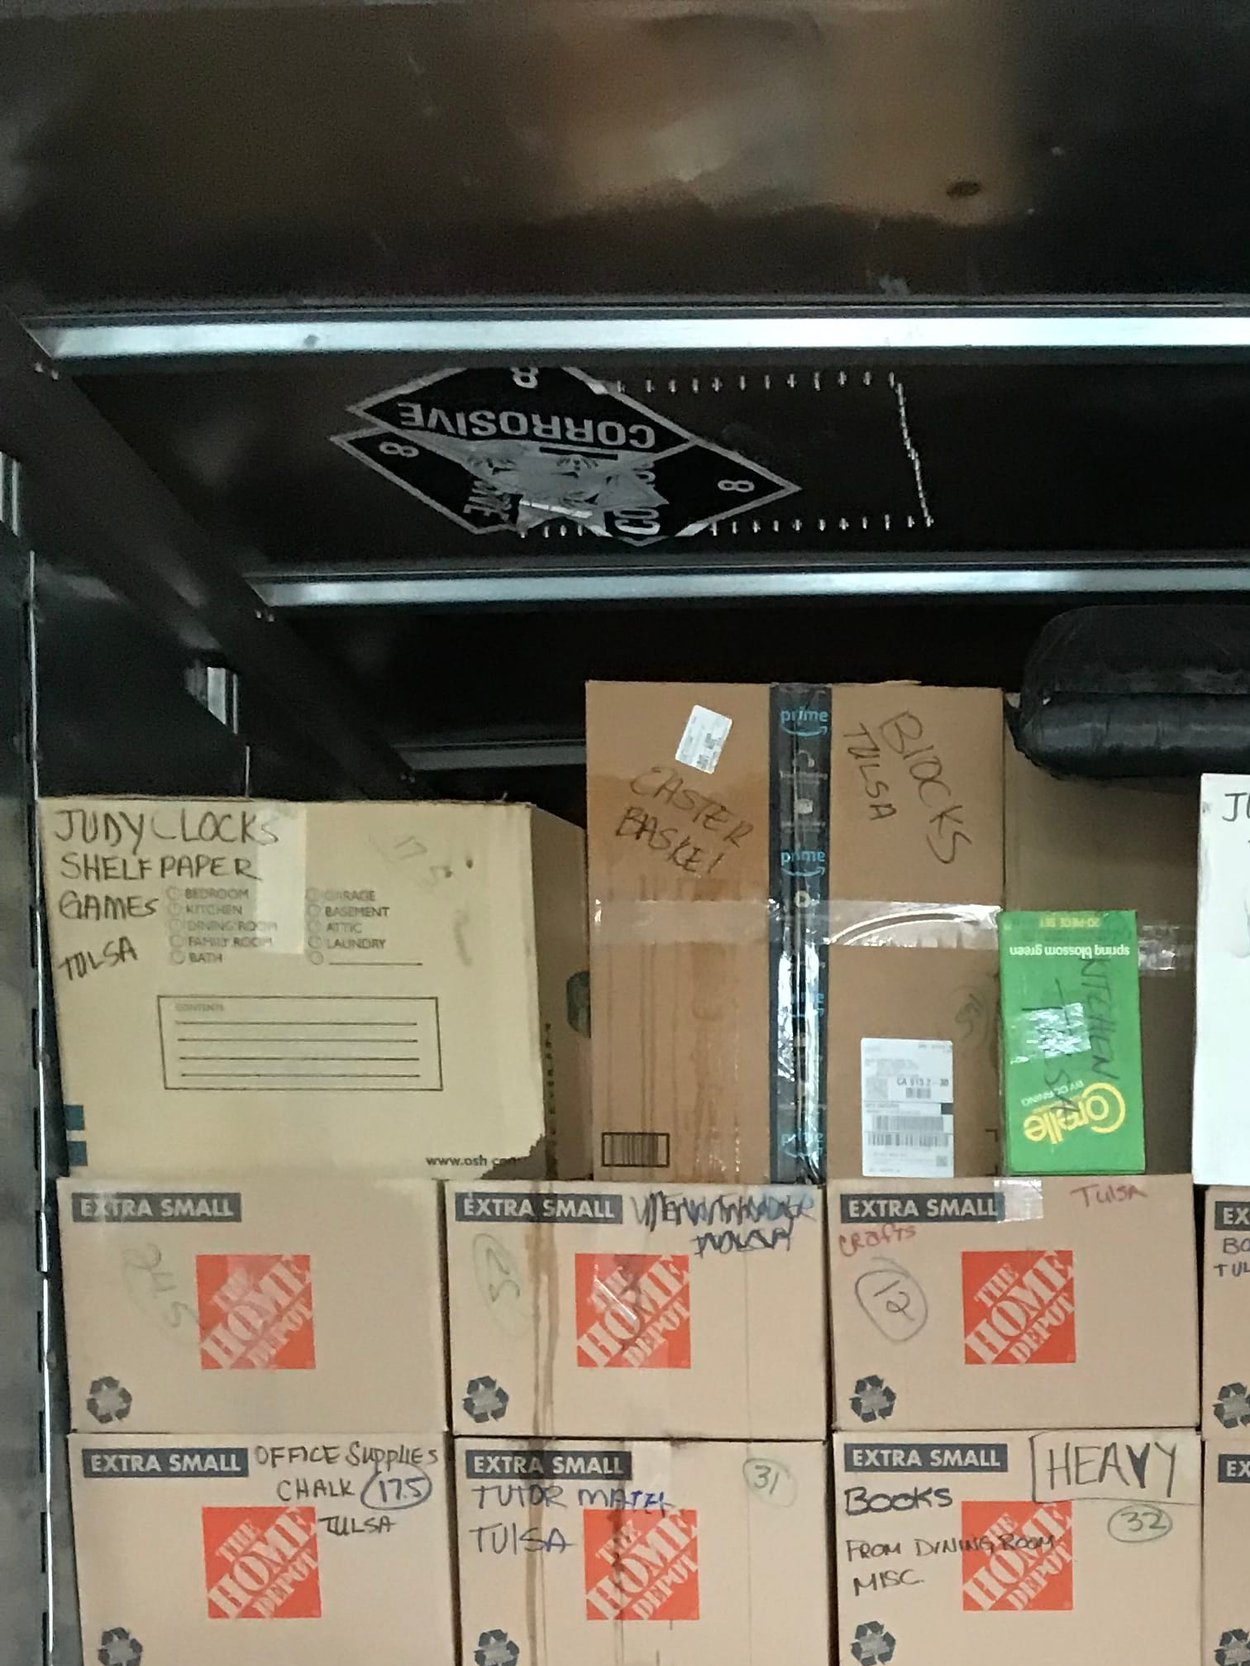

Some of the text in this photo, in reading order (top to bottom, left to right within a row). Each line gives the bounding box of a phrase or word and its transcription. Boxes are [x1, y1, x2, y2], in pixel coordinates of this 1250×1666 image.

[398, 402, 656, 448] CORROSIVE
[780, 708, 829, 725] prime
[55, 809, 279, 855] JUDY CLOCKS
[60, 853, 261, 880] SHELF PAPER
[326, 907, 390, 917] BASEMENT
[1010, 946, 1130, 958] spring blossom green
[1023, 1082, 1126, 1144] Corelle
[80, 1197, 235, 1217] EXTRA SMALL
[90, 1453, 242, 1473] EXTRA SMALL
[255, 1444, 340, 1469] OFFICE
[852, 1448, 1001, 1468] EXTRA SMALL
[1047, 1441, 1180, 1498] HEAVY
[278, 1478, 357, 1502] CHALK
[472, 1484, 568, 1509] TUTOR
[319, 1516, 396, 1537] TULSA
[846, 1533, 1056, 1562] FROM DINING ROOM
